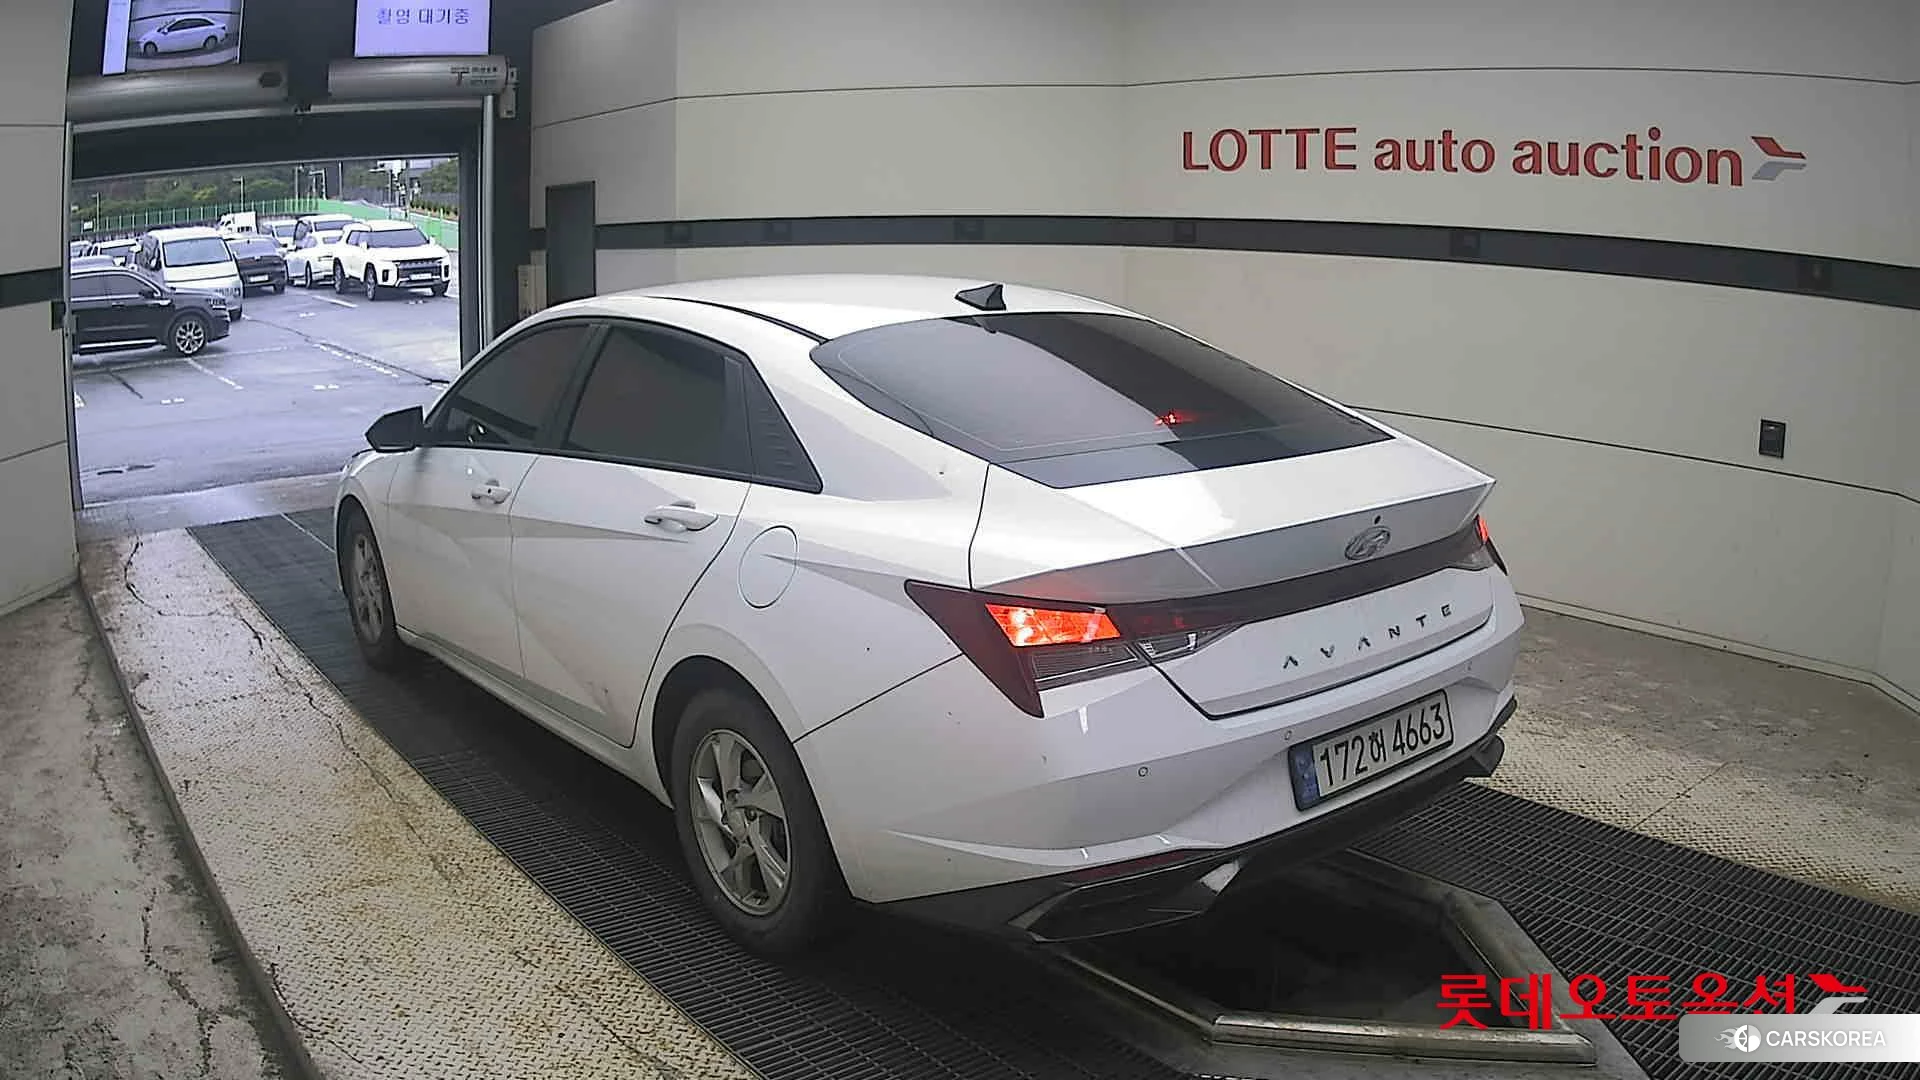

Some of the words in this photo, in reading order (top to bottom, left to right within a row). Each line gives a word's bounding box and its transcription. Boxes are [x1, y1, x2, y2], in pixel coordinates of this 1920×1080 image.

[418, 8, 469, 24] 대기중
[1182, 128, 1357, 173] LOTTE
[1373, 130, 1496, 174] auto
[1511, 126, 1744, 187] auction
[1283, 604, 1452, 669] AVANTE
[1392, 702, 1445, 755] 4663
